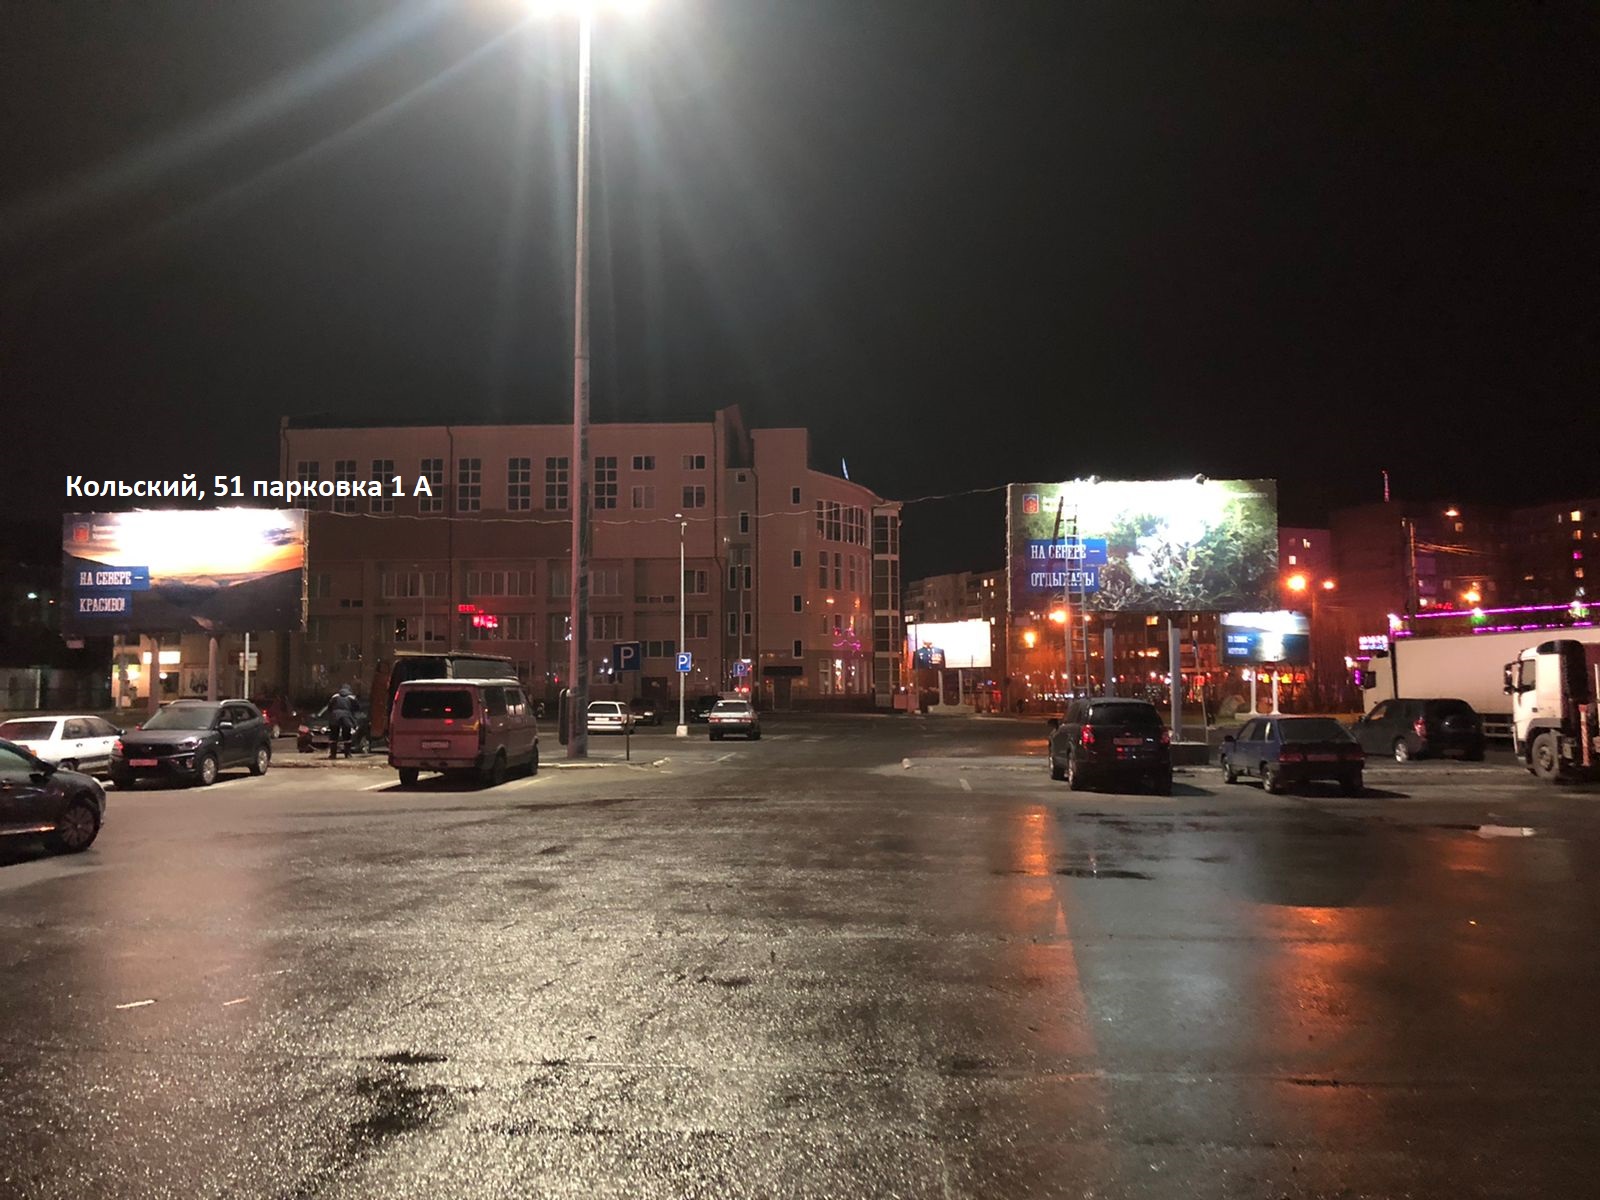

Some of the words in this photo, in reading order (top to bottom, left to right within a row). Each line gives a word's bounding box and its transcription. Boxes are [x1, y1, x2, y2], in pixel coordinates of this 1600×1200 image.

[1031, 545, 1045, 559] НА
[80, 572, 93, 586] НА
[96, 571, 132, 586] СЕВЕРЕ
[80, 597, 126, 612] КРАСИВО!
[621, 647, 634, 668] P
[679, 655, 688, 669] P
